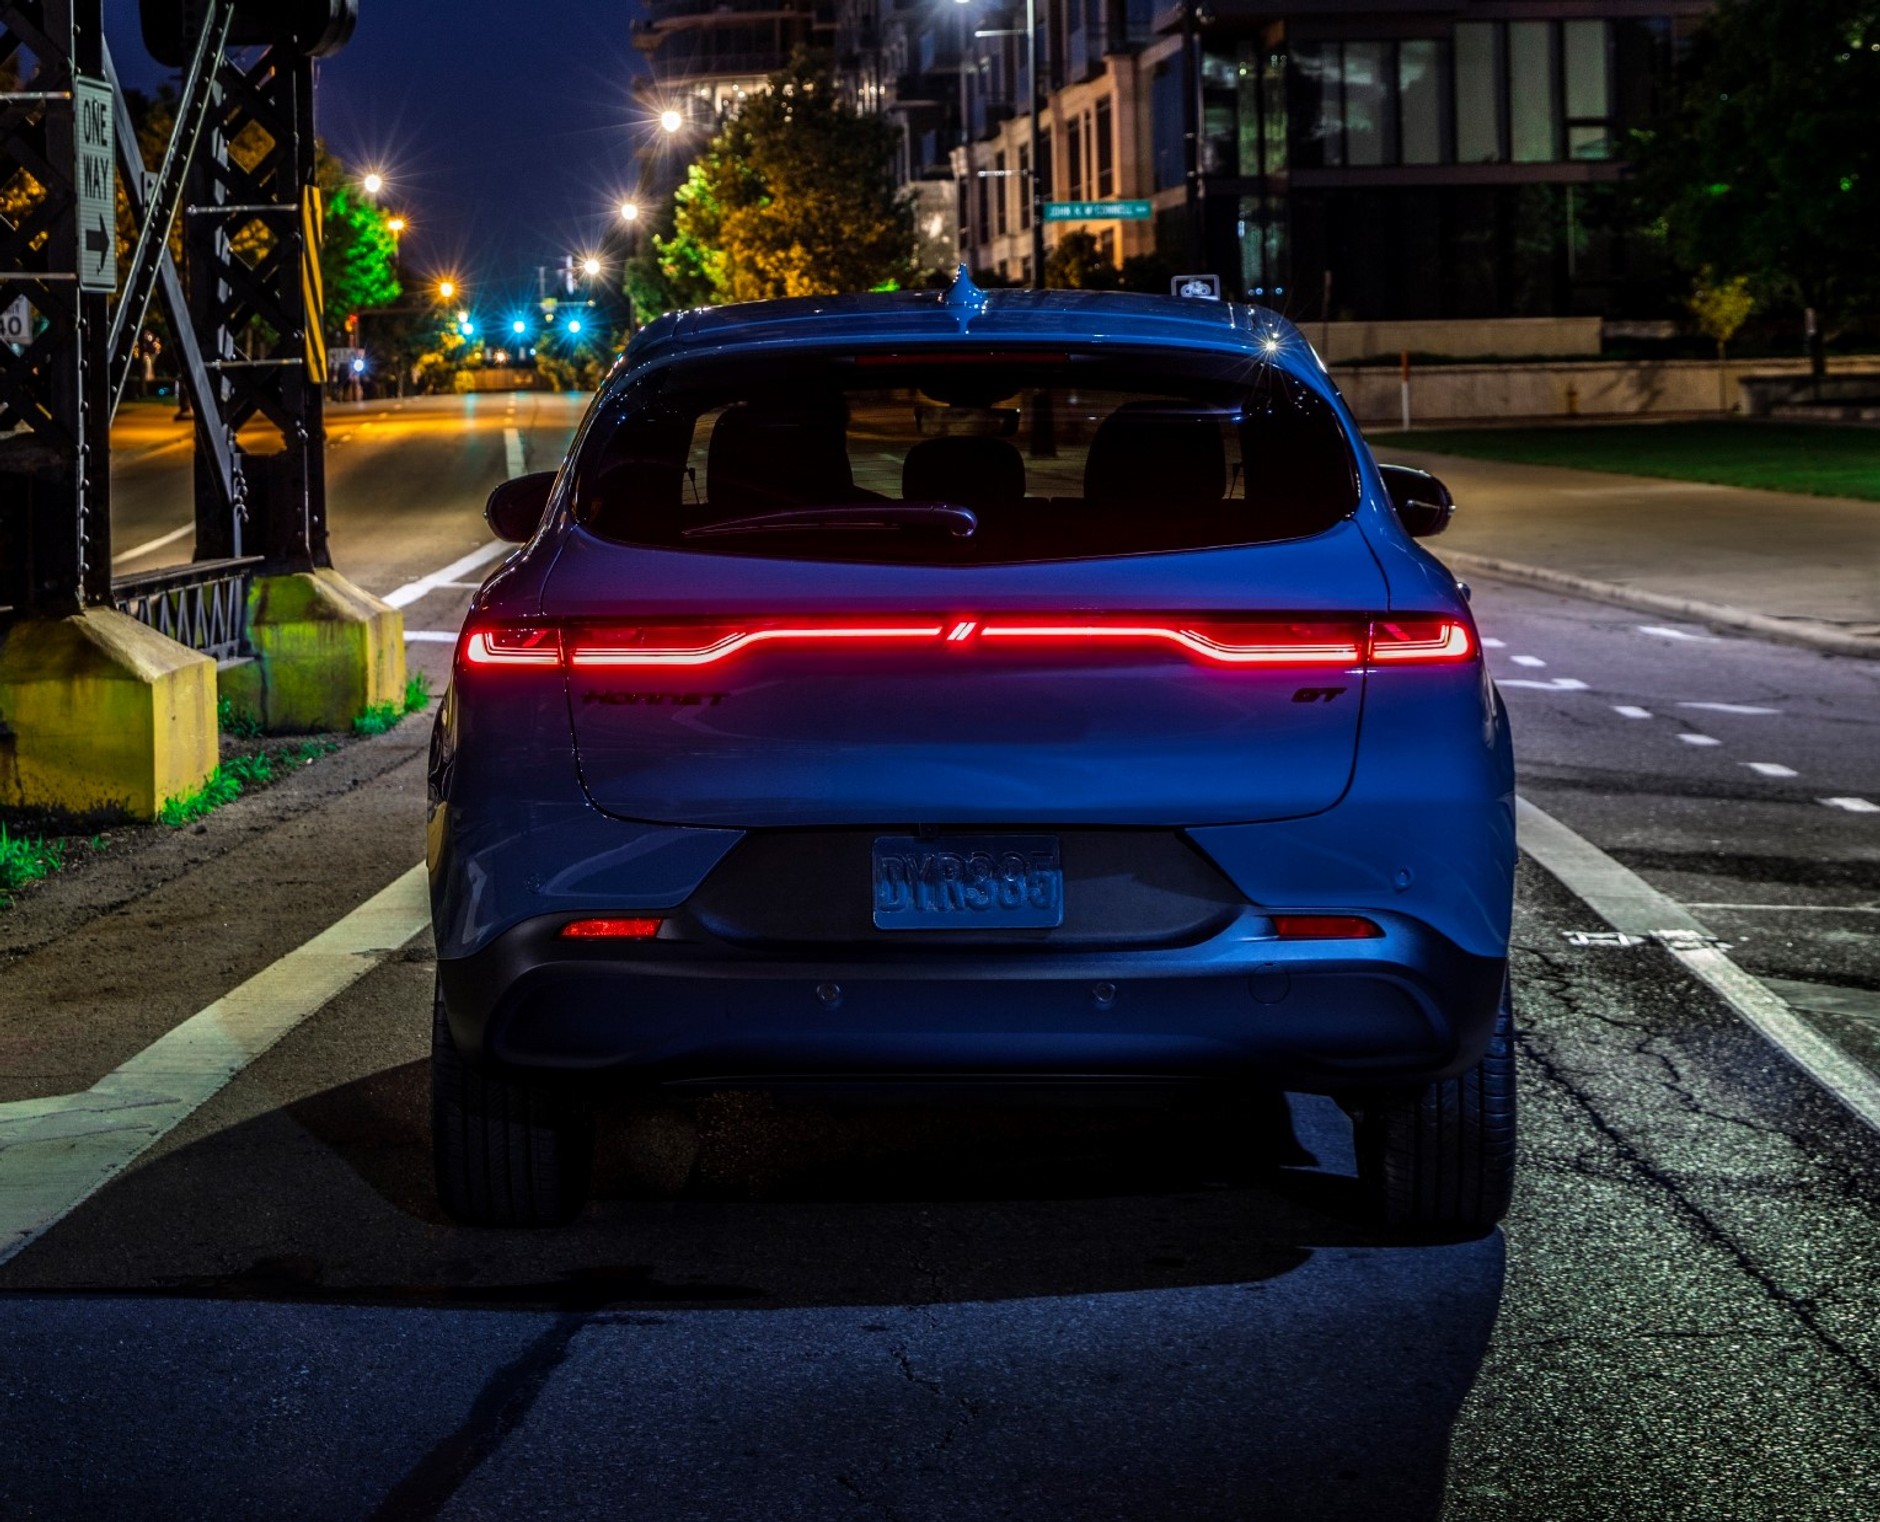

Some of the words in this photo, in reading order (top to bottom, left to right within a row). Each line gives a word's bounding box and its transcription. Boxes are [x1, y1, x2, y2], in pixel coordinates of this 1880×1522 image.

[84, 98, 107, 147] ONE
[84, 153, 109, 200] WAY
[1050, 206, 1071, 217] JOHN
[581, 690, 731, 706] HORNET
[1291, 687, 1347, 703] GT
